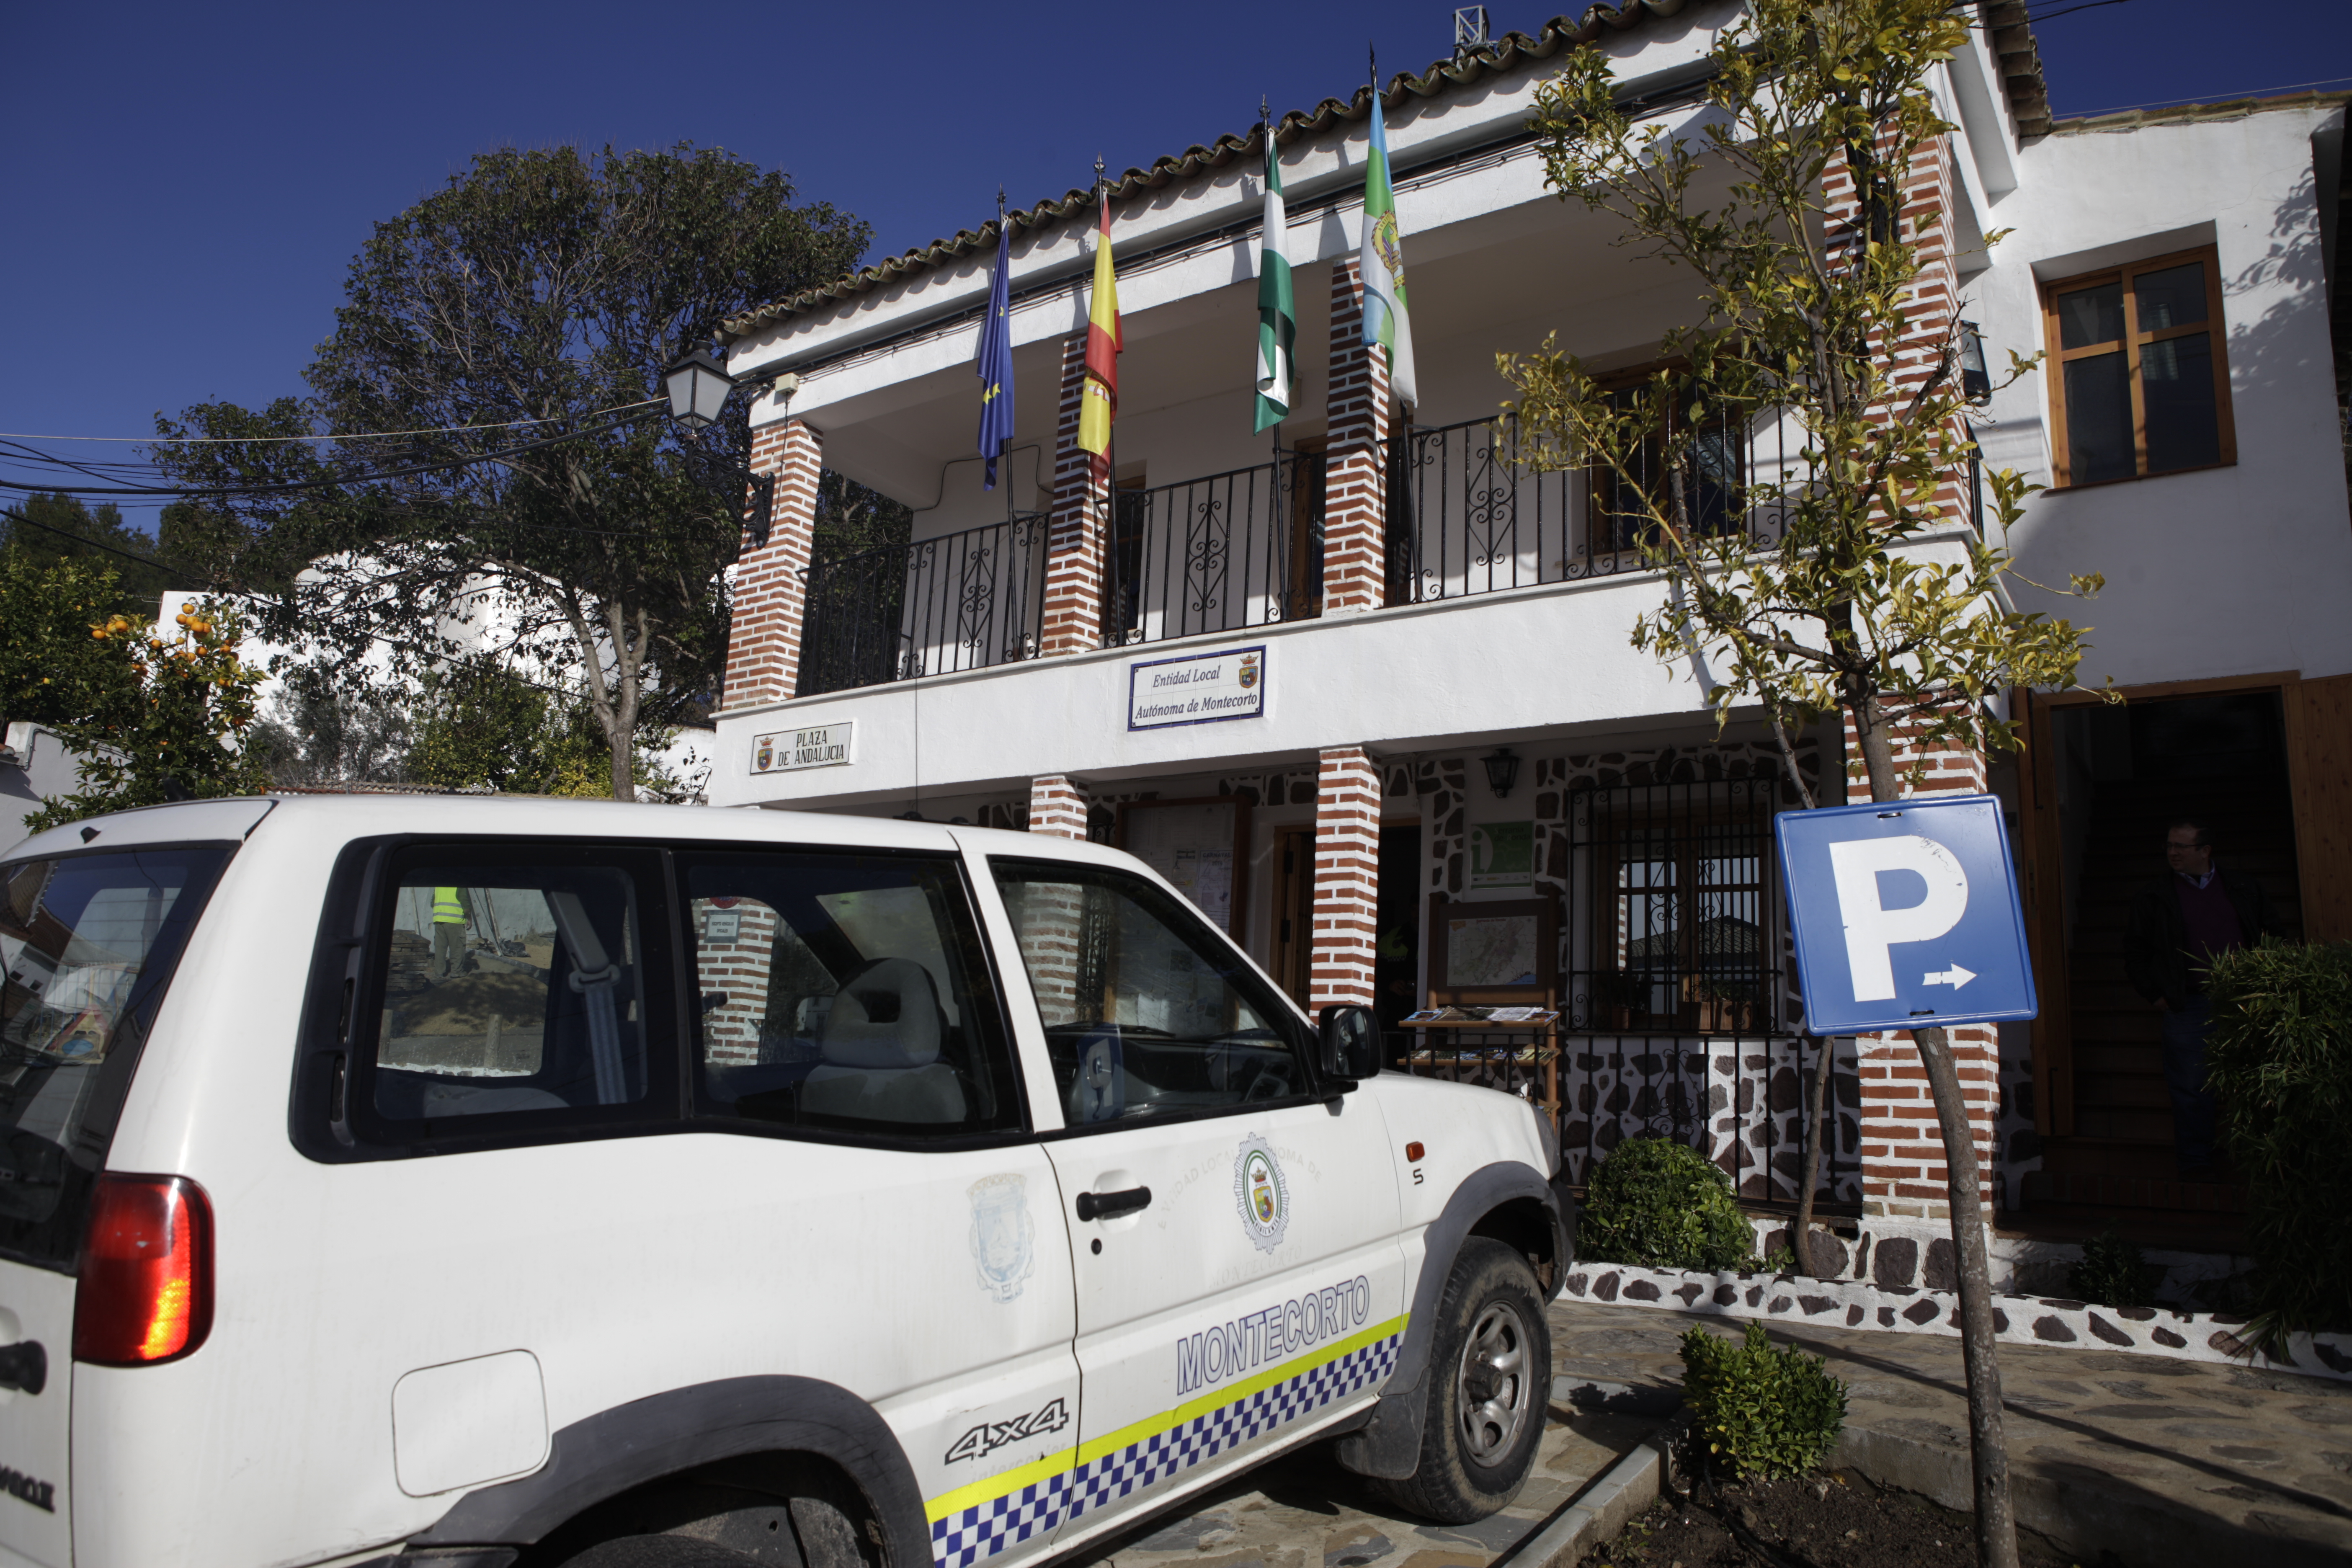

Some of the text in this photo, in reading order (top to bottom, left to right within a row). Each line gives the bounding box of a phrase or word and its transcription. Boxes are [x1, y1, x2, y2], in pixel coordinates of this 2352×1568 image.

[1153, 665, 1221, 688] Entidad Local
[1135, 692, 1258, 719] Autónoma de Montecorto
[796, 730, 828, 748] PLAZA
[778, 744, 844, 767] DE ANDALUCIA
[1829, 835, 1968, 1002] P
[1177, 1275, 1370, 1396] MONTECORTO
